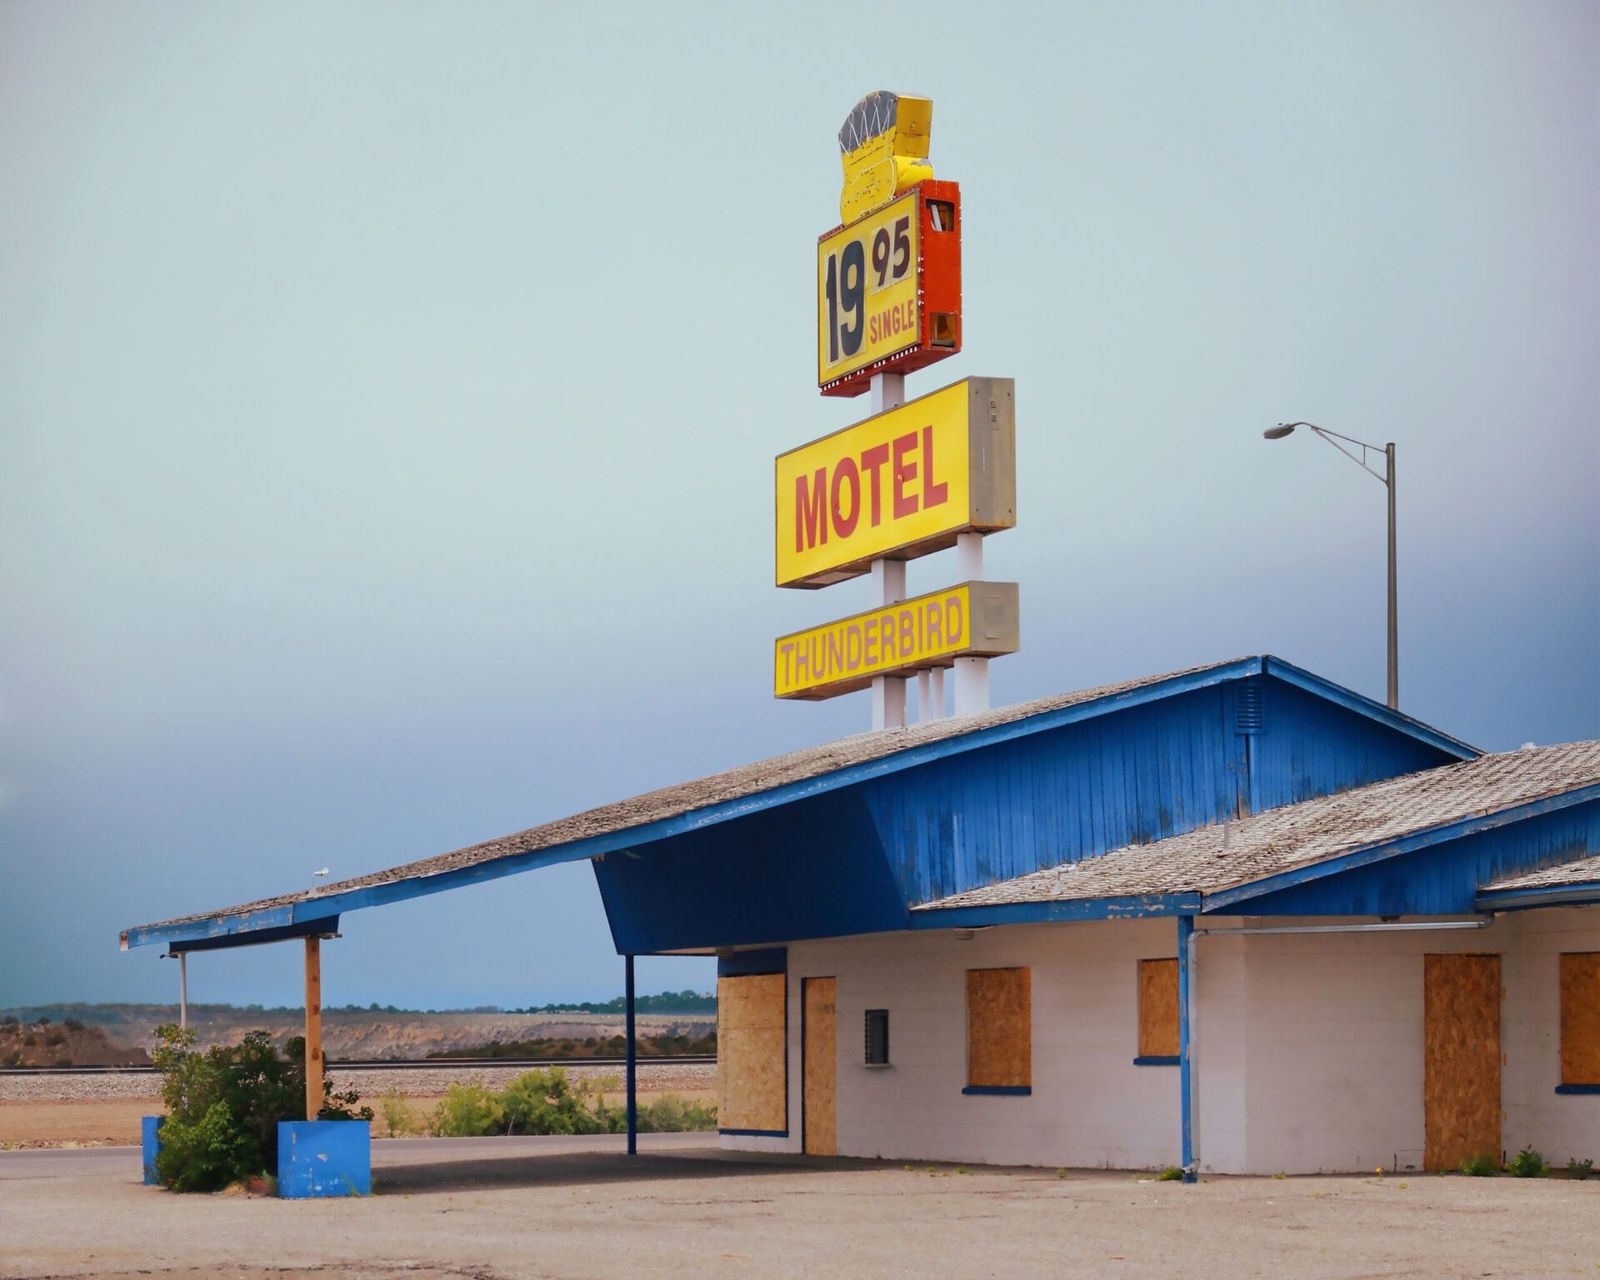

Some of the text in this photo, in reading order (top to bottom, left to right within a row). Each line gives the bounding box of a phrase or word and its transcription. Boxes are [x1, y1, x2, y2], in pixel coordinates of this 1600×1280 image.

[826, 216, 910, 363] 19 95
[870, 299, 914, 345] SINGLE
[795, 425, 948, 553] MOTEL
[780, 596, 963, 687] THUNDERBIRD
